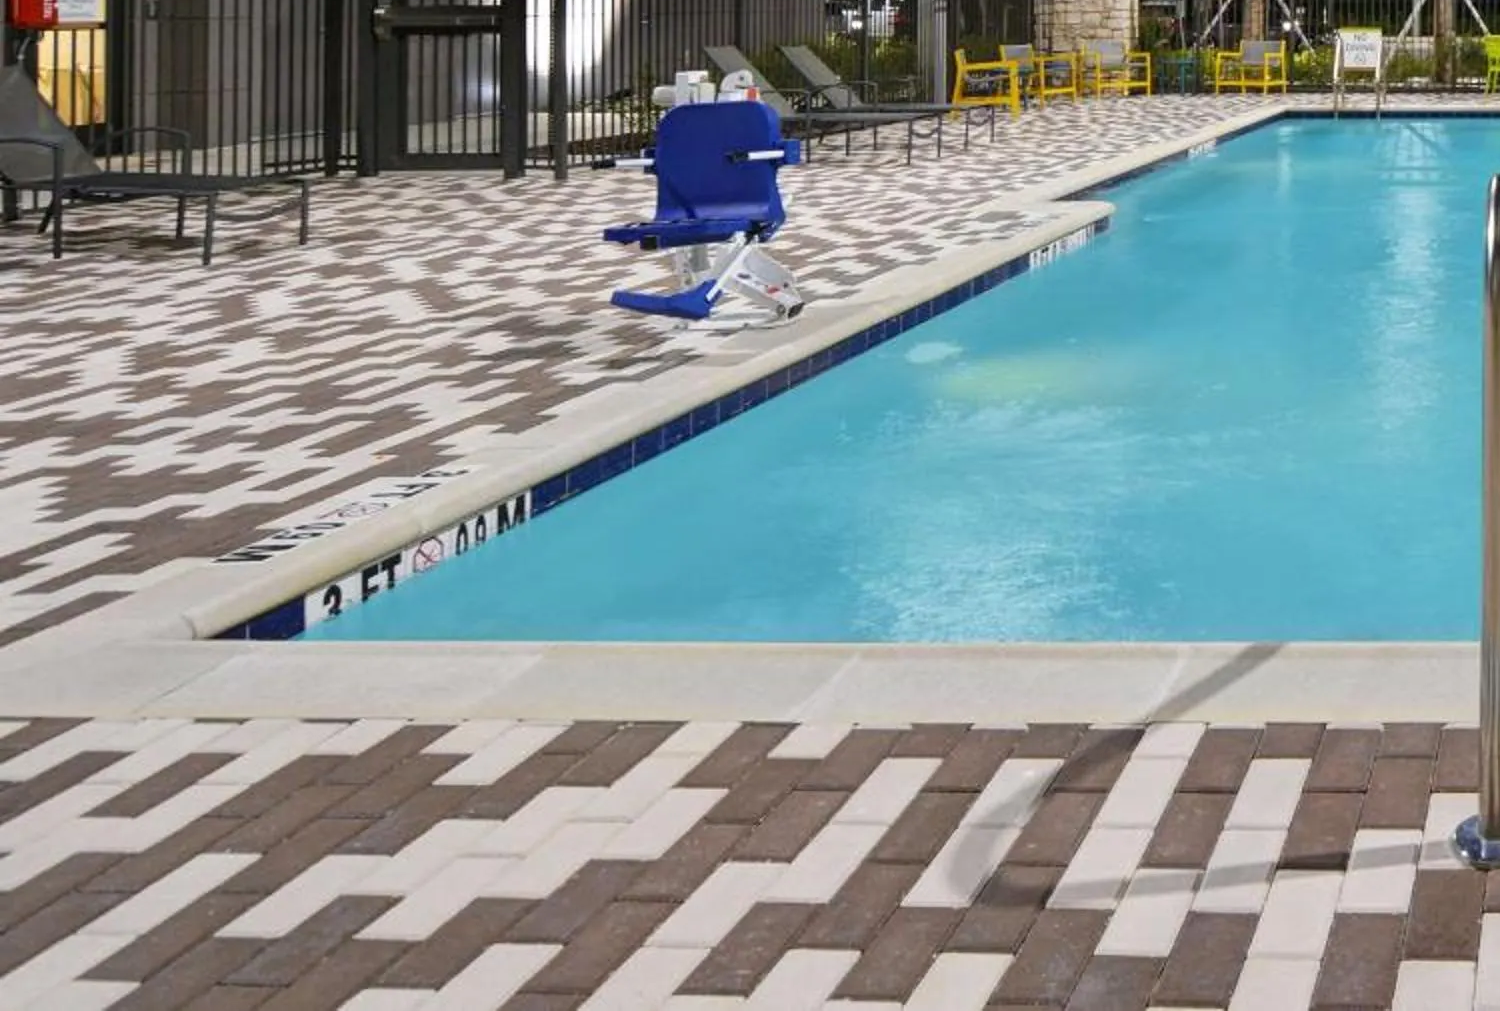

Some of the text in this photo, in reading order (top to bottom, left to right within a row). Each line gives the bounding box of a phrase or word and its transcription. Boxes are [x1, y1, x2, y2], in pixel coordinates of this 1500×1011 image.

[323, 584, 343, 620] 3
[361, 553, 402, 604] FT
[496, 494, 526, 536] M
